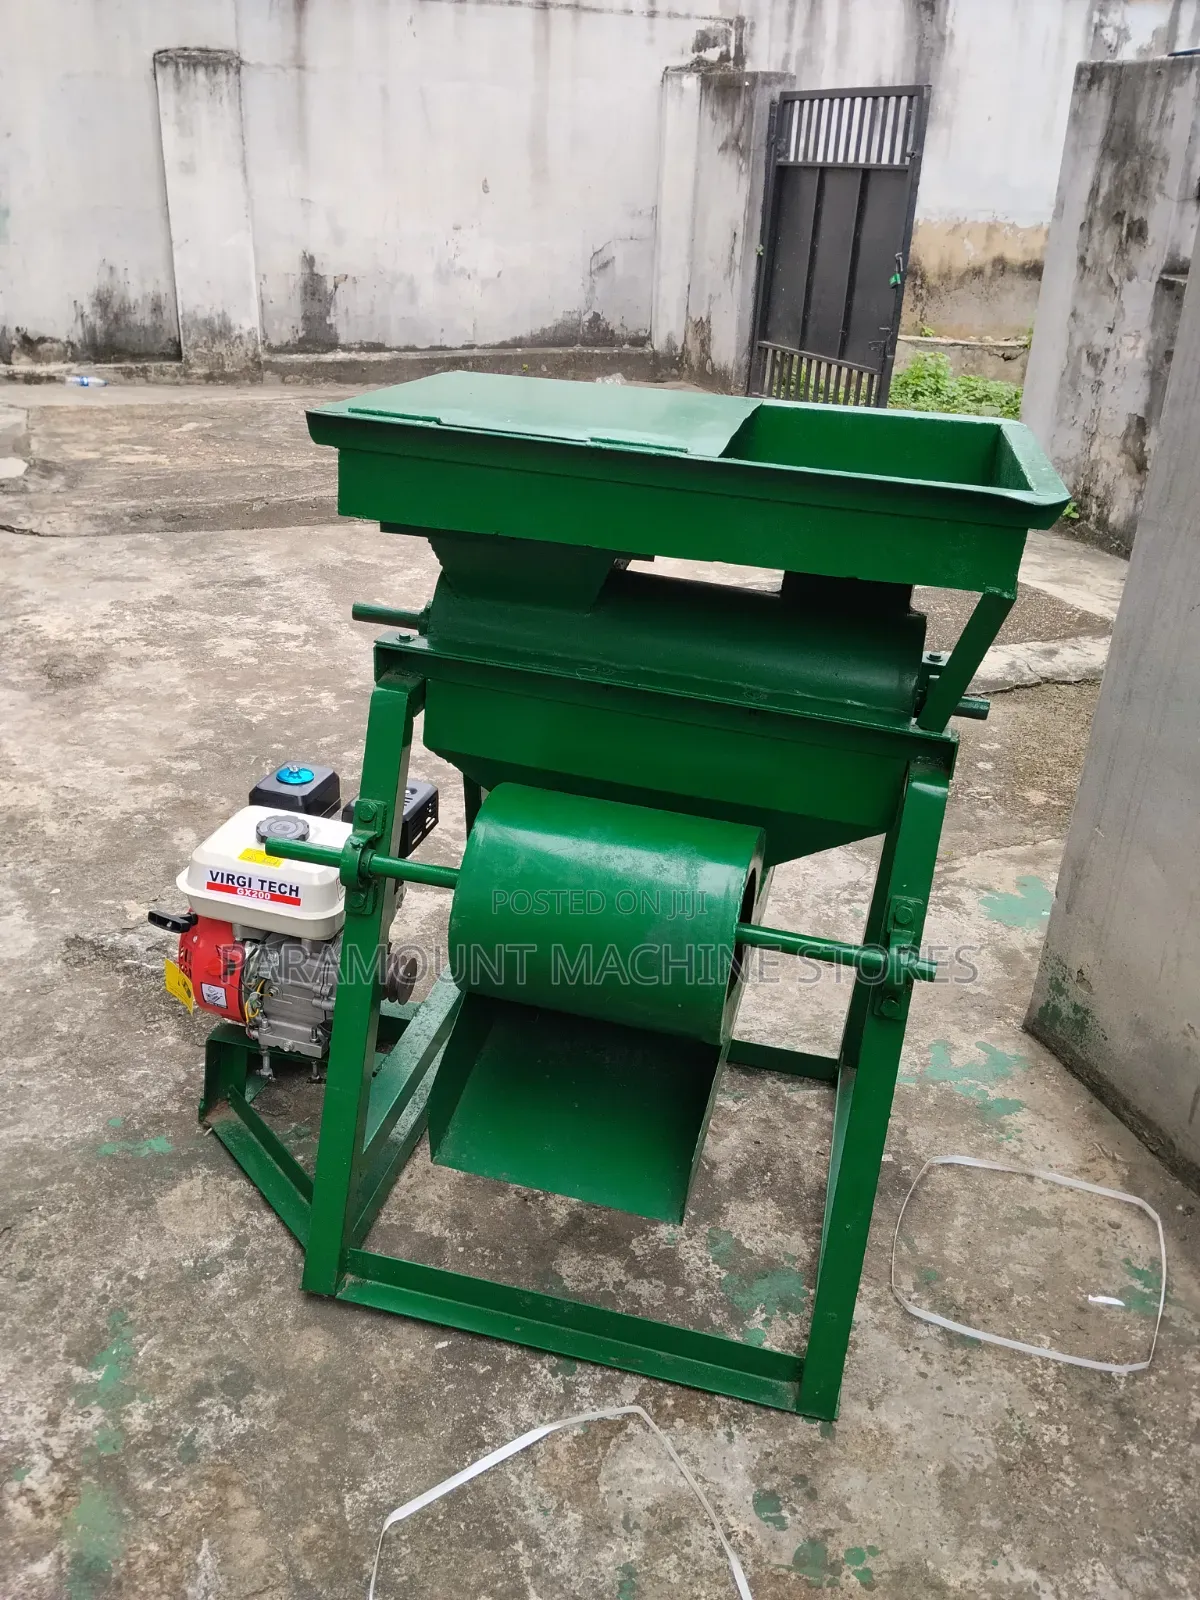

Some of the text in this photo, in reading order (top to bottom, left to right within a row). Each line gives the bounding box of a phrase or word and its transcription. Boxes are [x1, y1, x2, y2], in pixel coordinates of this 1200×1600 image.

[209, 870, 300, 897] VIRGI TECH
[236, 887, 271, 900] GX200
